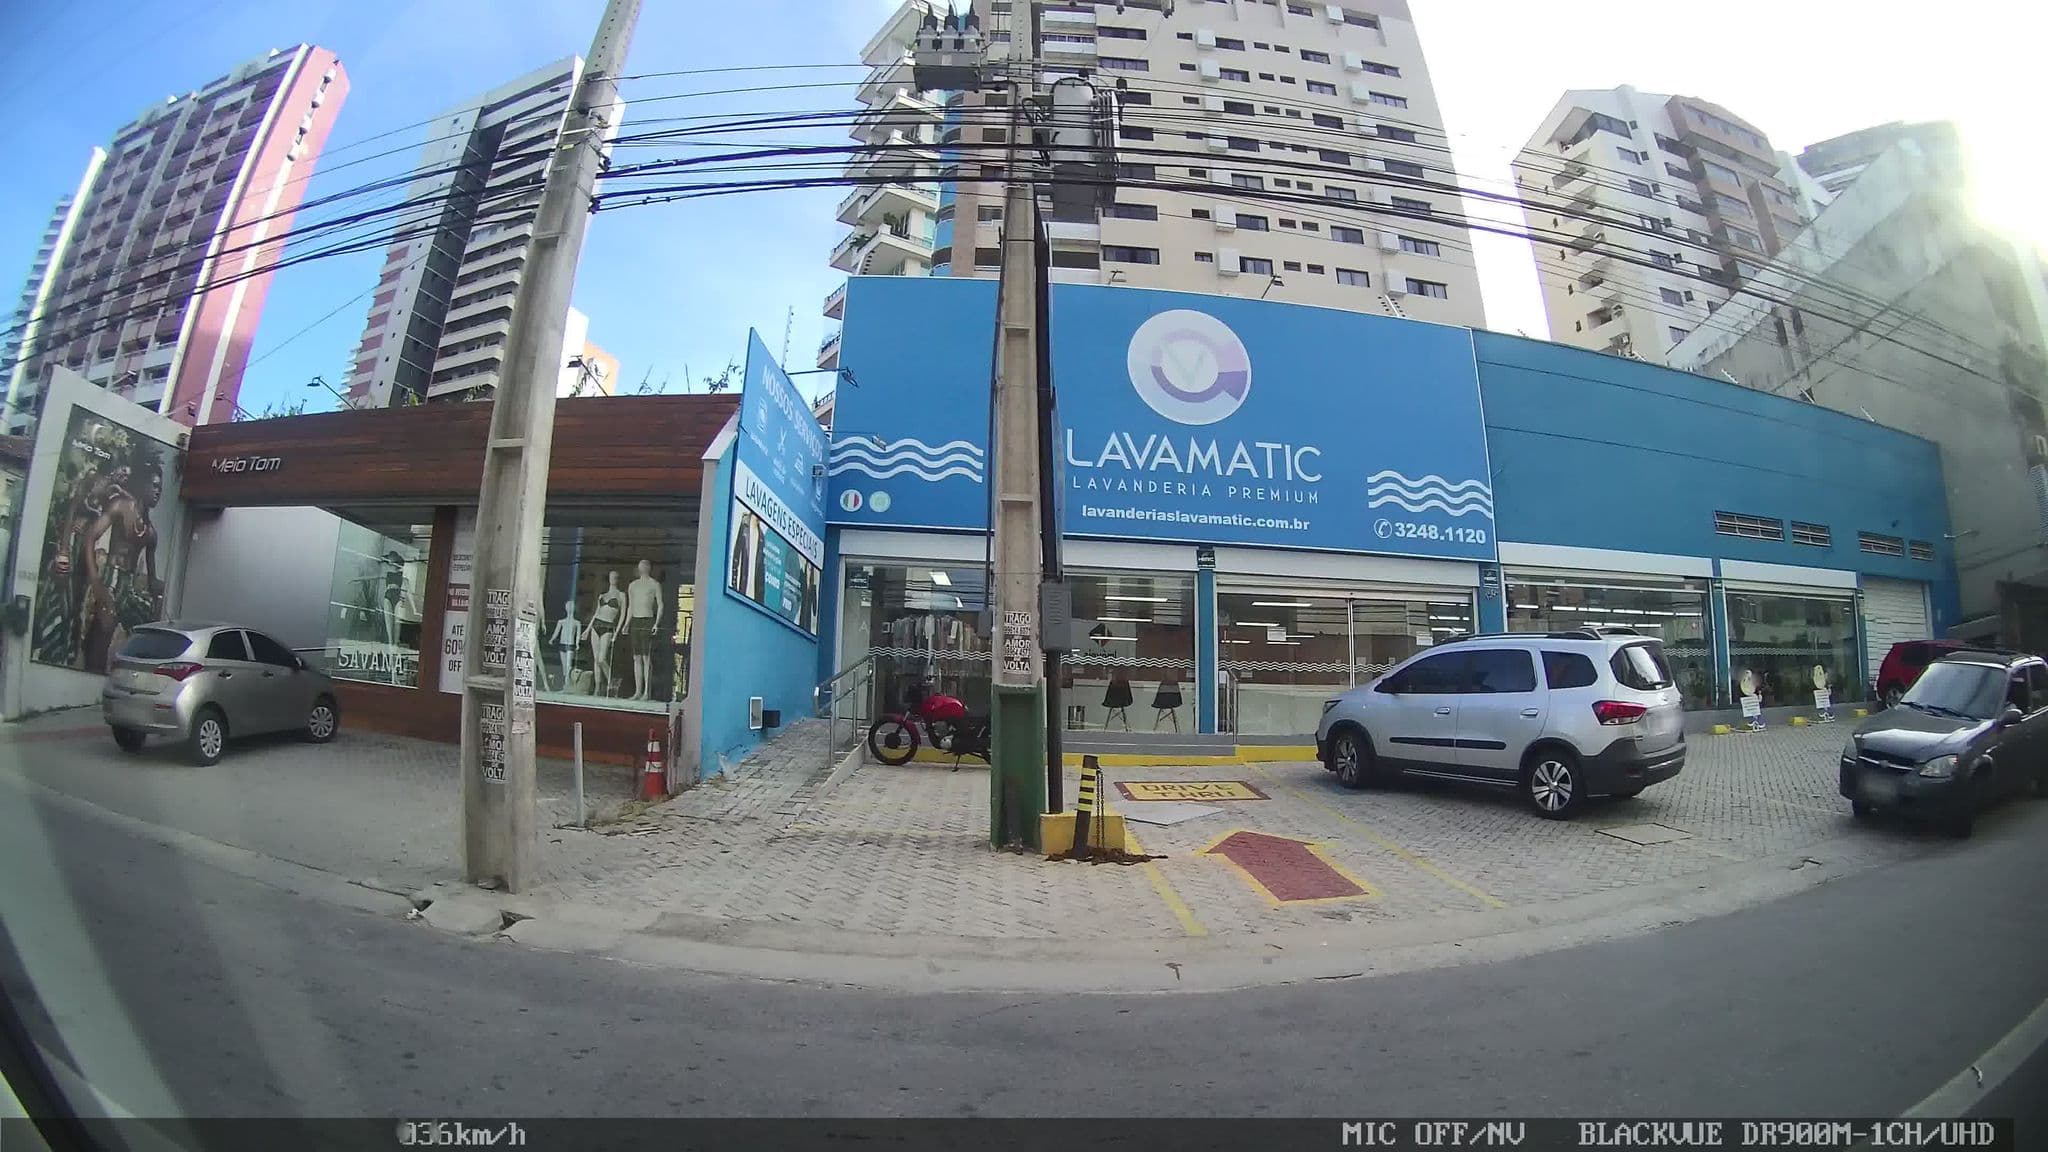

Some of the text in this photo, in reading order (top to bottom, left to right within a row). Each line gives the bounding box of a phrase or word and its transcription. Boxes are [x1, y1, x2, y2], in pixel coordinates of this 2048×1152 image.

[762, 364, 793, 422] NOSSOS
[93, 446, 111, 460] Tom
[1067, 428, 1323, 482] LAVAMATIC
[212, 456, 282, 473] Meio Tom
[1073, 475, 1319, 504] LAVANDERIA PREMIUM
[746, 478, 787, 531] LAVAGENS
[787, 518, 818, 559] ESPECIAIS
[1082, 505, 1310, 530] lavanderiaslavamatic.com.br
[1394, 521, 1487, 545] 3248.1120
[1005, 613, 1031, 625] TRAGO
[486, 624, 507, 636] AMO
[1004, 639, 1031, 648] AMOR
[338, 648, 404, 674] SAVANA
[448, 659, 463, 672] OFF
[1004, 661, 1030, 671] VOLTA
[1141, 783, 1233, 792] DRIVE
